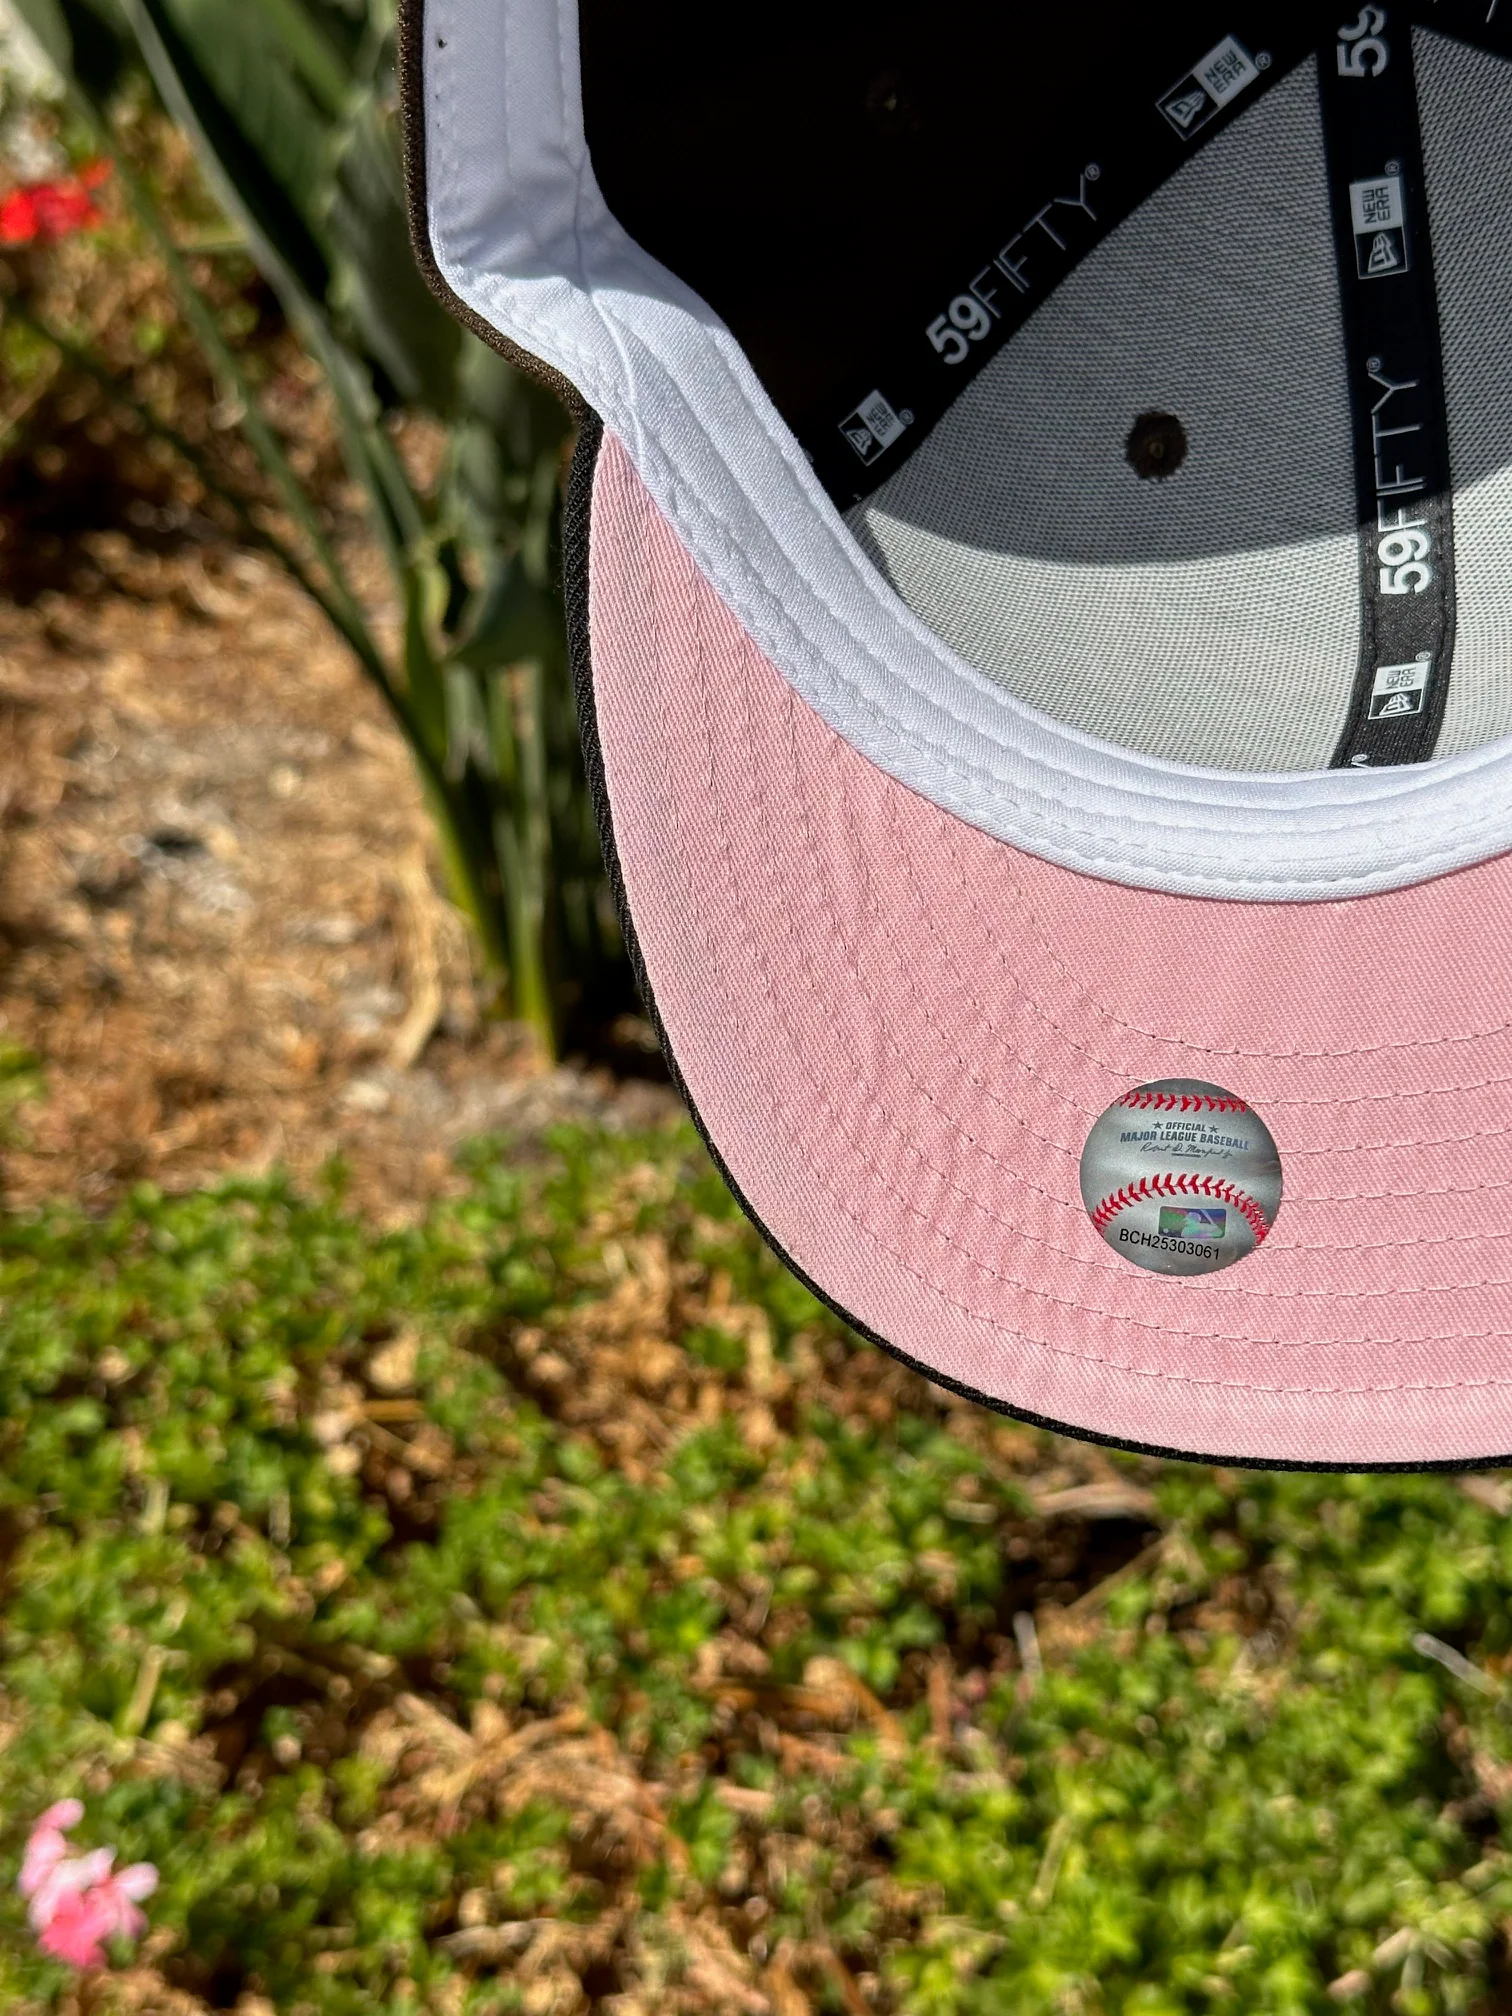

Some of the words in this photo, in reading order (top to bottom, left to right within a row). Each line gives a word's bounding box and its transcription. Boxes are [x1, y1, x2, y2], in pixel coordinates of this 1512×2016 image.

[1203, 49, 1237, 84] NEW
[1213, 62, 1246, 93] ERA
[1362, 189, 1377, 224] NEW
[1375, 186, 1391, 221] ERA
[1120, 1131, 1157, 1142] MAJOR
[1160, 1131, 1197, 1142] LEAGUE
[1199, 1133, 1249, 1150] BASEBALL
[1165, 1121, 1207, 1132] OFFICIAL
[1119, 1228, 1219, 1260] BCH25303061
